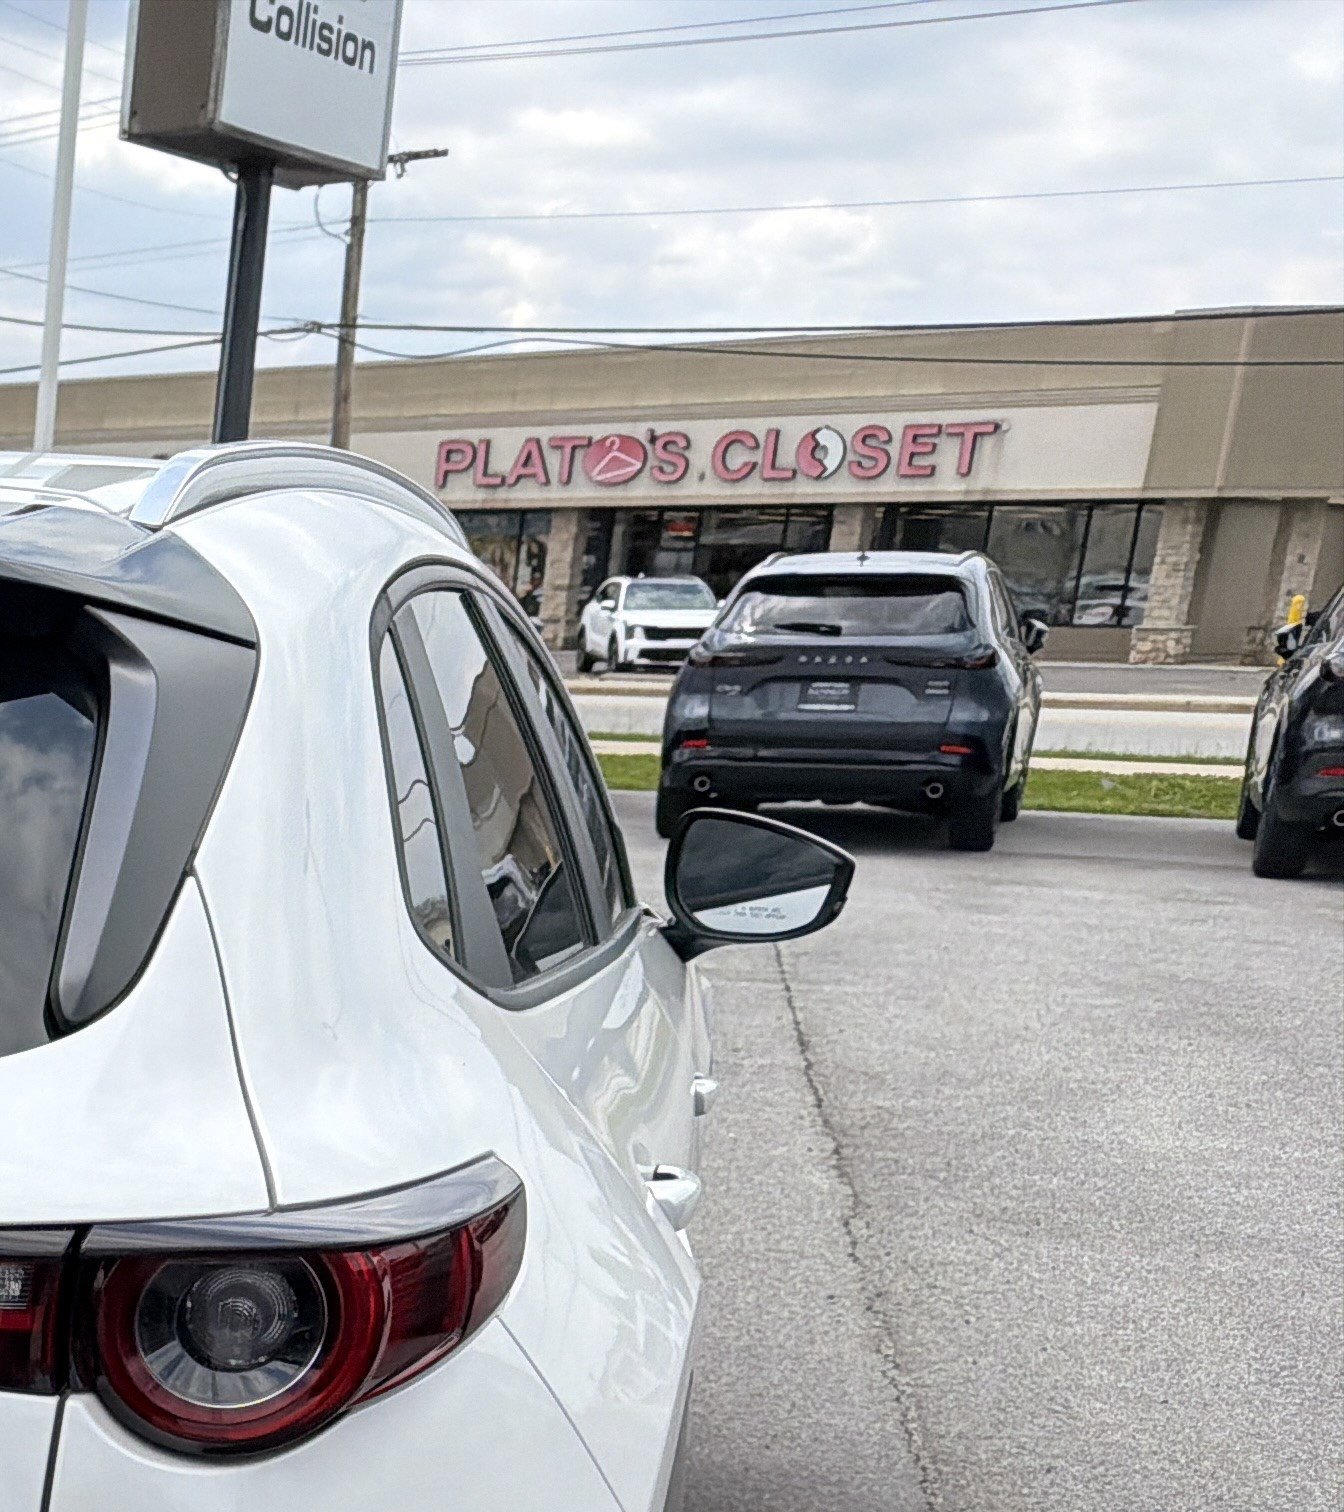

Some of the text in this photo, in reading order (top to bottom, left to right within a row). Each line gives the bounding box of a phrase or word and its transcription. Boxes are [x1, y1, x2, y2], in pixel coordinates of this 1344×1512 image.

[248, 0, 376, 75] Collision
[433, 421, 1002, 489] PLATO'S CLOSET
